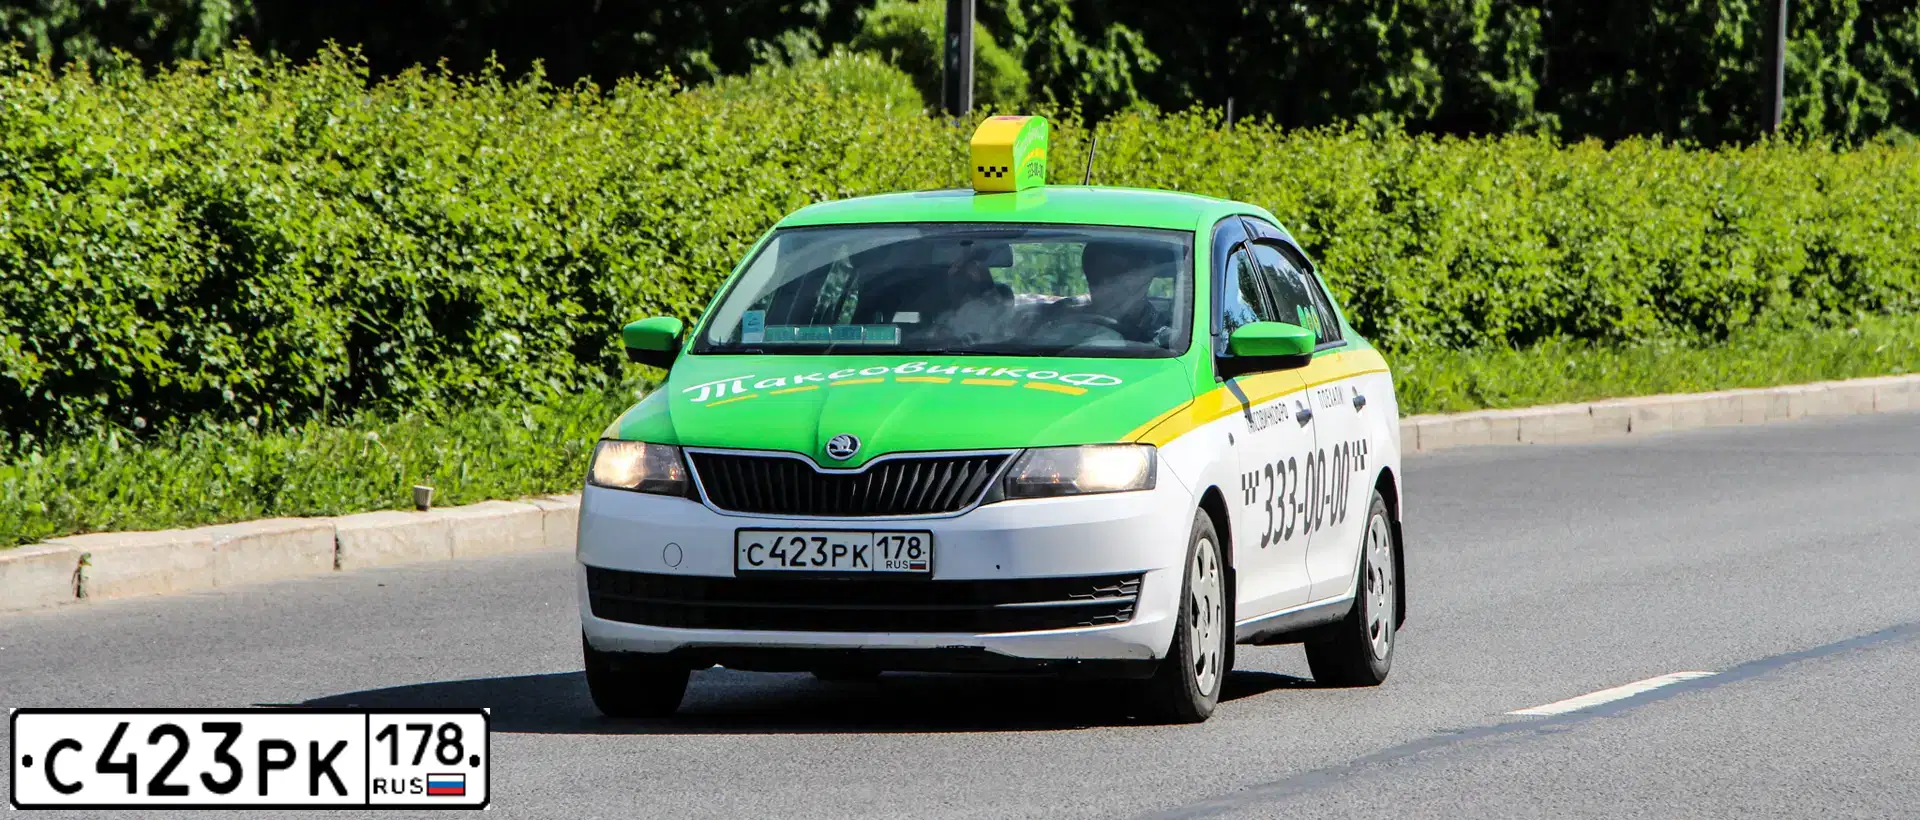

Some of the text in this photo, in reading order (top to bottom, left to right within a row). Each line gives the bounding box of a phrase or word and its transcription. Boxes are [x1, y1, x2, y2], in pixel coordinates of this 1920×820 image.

[1261, 441, 1350, 549] 333-00-00
[876, 536, 921, 560] 178
[886, 560, 908, 569] RUS
